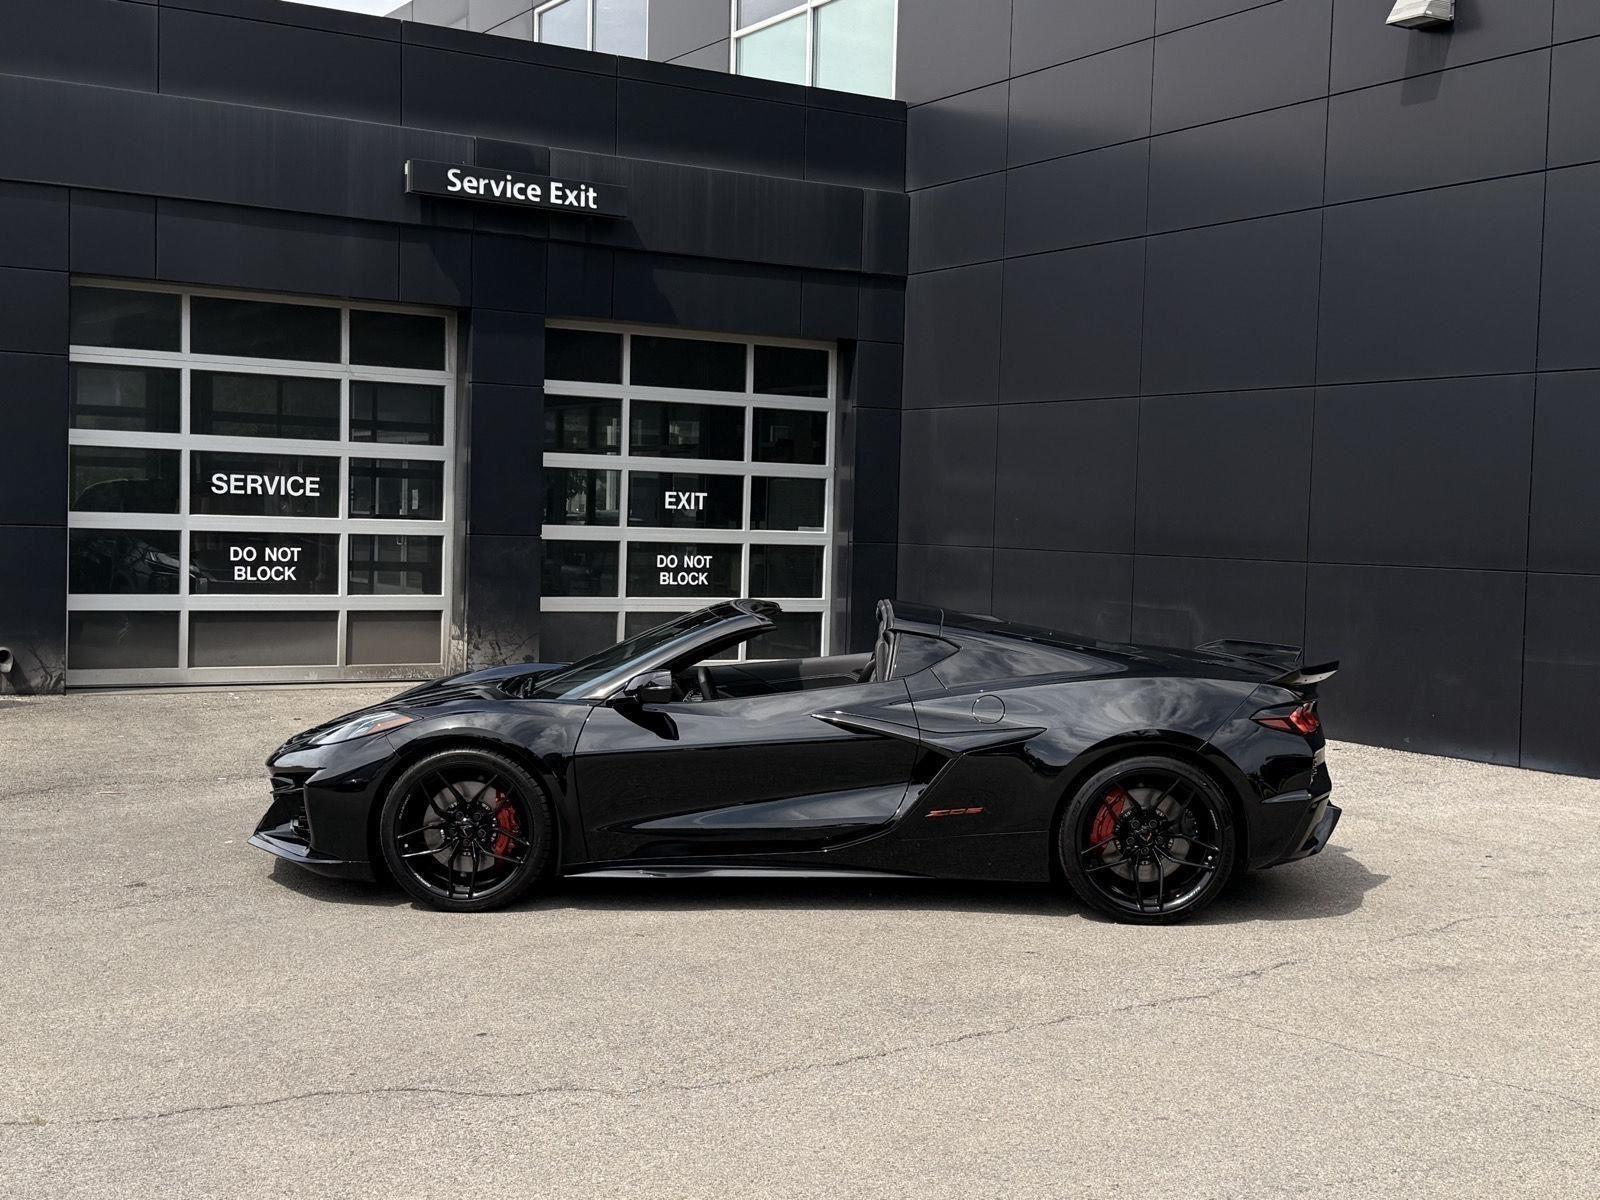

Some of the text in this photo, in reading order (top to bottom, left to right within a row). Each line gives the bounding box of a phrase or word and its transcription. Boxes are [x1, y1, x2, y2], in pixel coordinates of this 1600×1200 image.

[447, 168, 598, 209] Service Exit
[211, 473, 320, 497] SERVICE
[664, 491, 708, 510] EXIT
[229, 546, 302, 562] DO NOT
[656, 554, 713, 569] DO NOT
[234, 566, 297, 582] BLOCK
[659, 571, 709, 586] BLOCK
